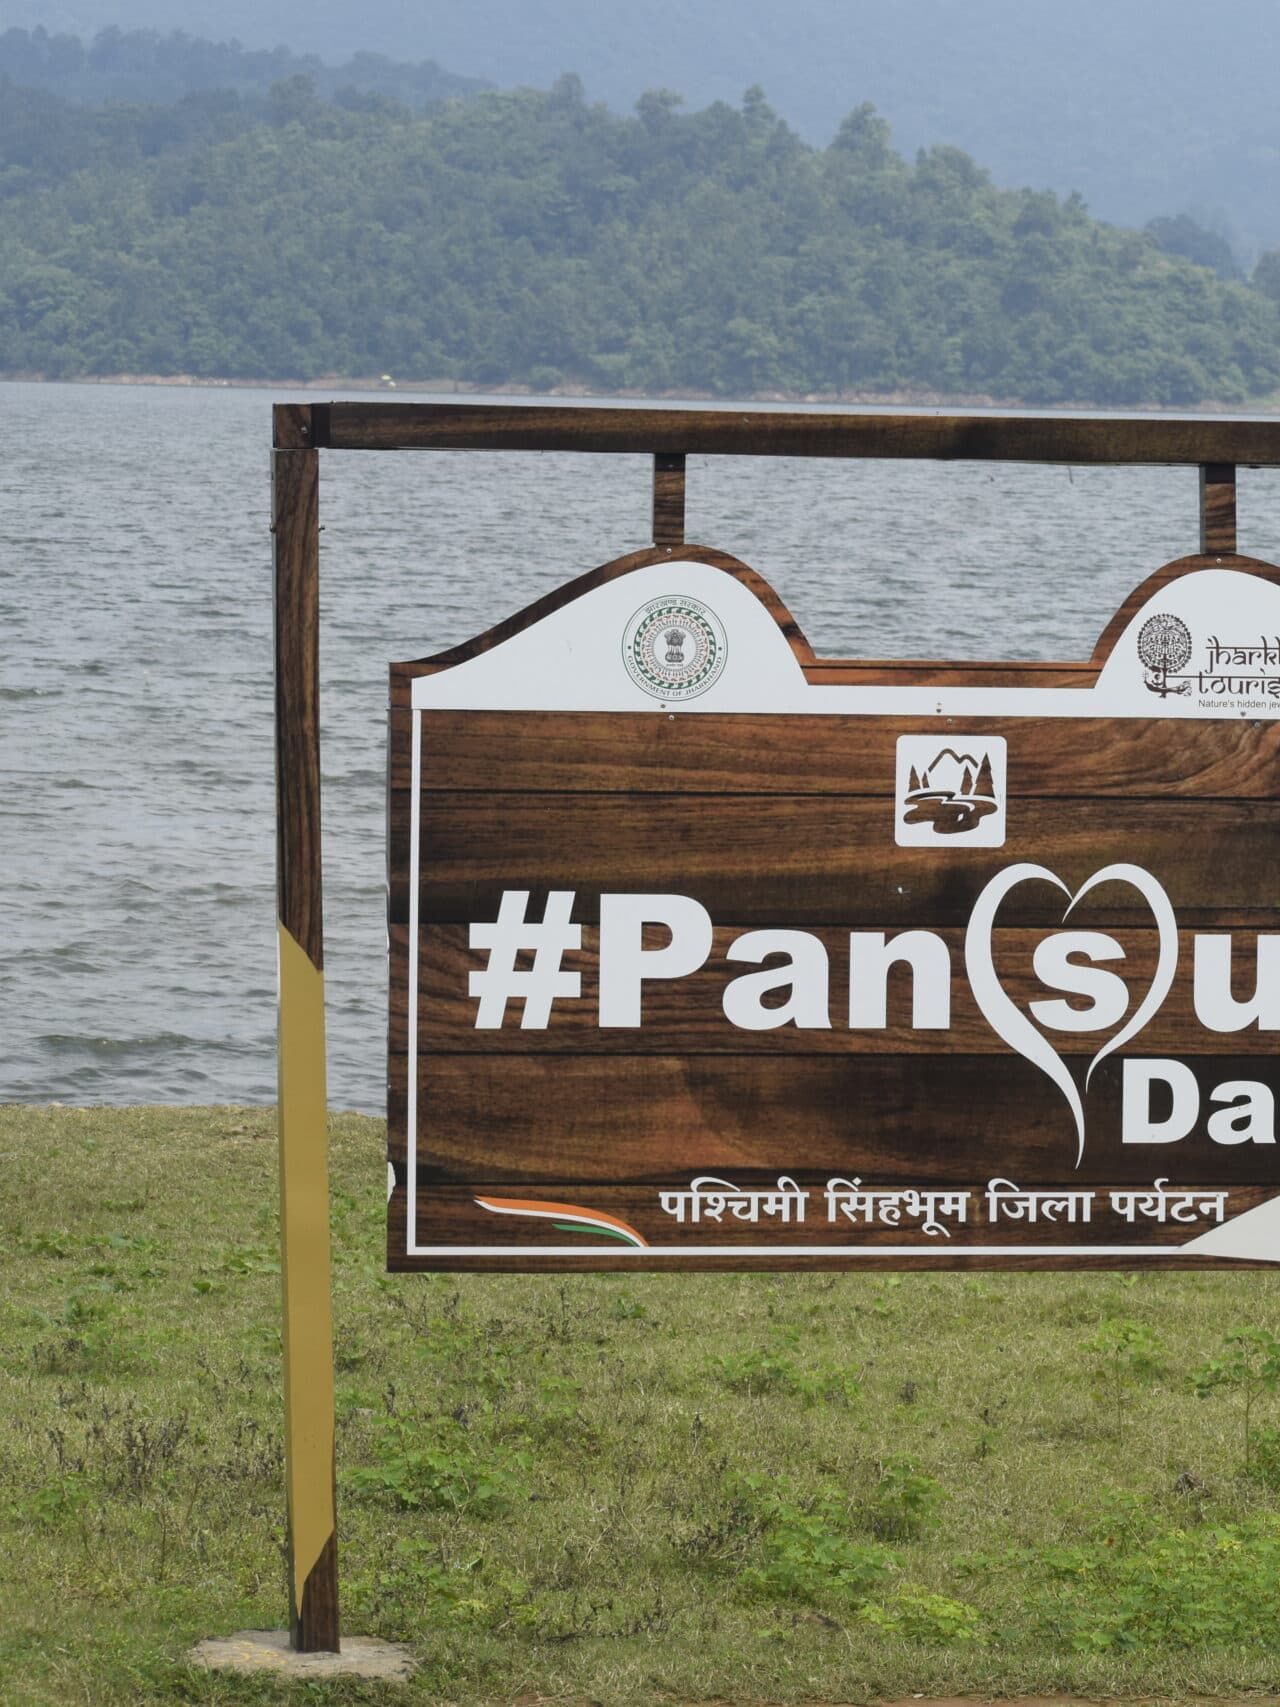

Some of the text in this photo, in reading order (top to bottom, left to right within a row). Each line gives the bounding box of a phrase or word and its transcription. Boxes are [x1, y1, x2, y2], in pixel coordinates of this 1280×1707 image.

[627, 655, 670, 697] GOVERNMENT
[685, 656, 722, 696] JHARKHAND
[1198, 699, 1235, 709] Nature's
[1237, 699, 1267, 709] hidden
[658, 1176, 1229, 1238] पश्चिमी सिंहभूम जिला पर्यटन
